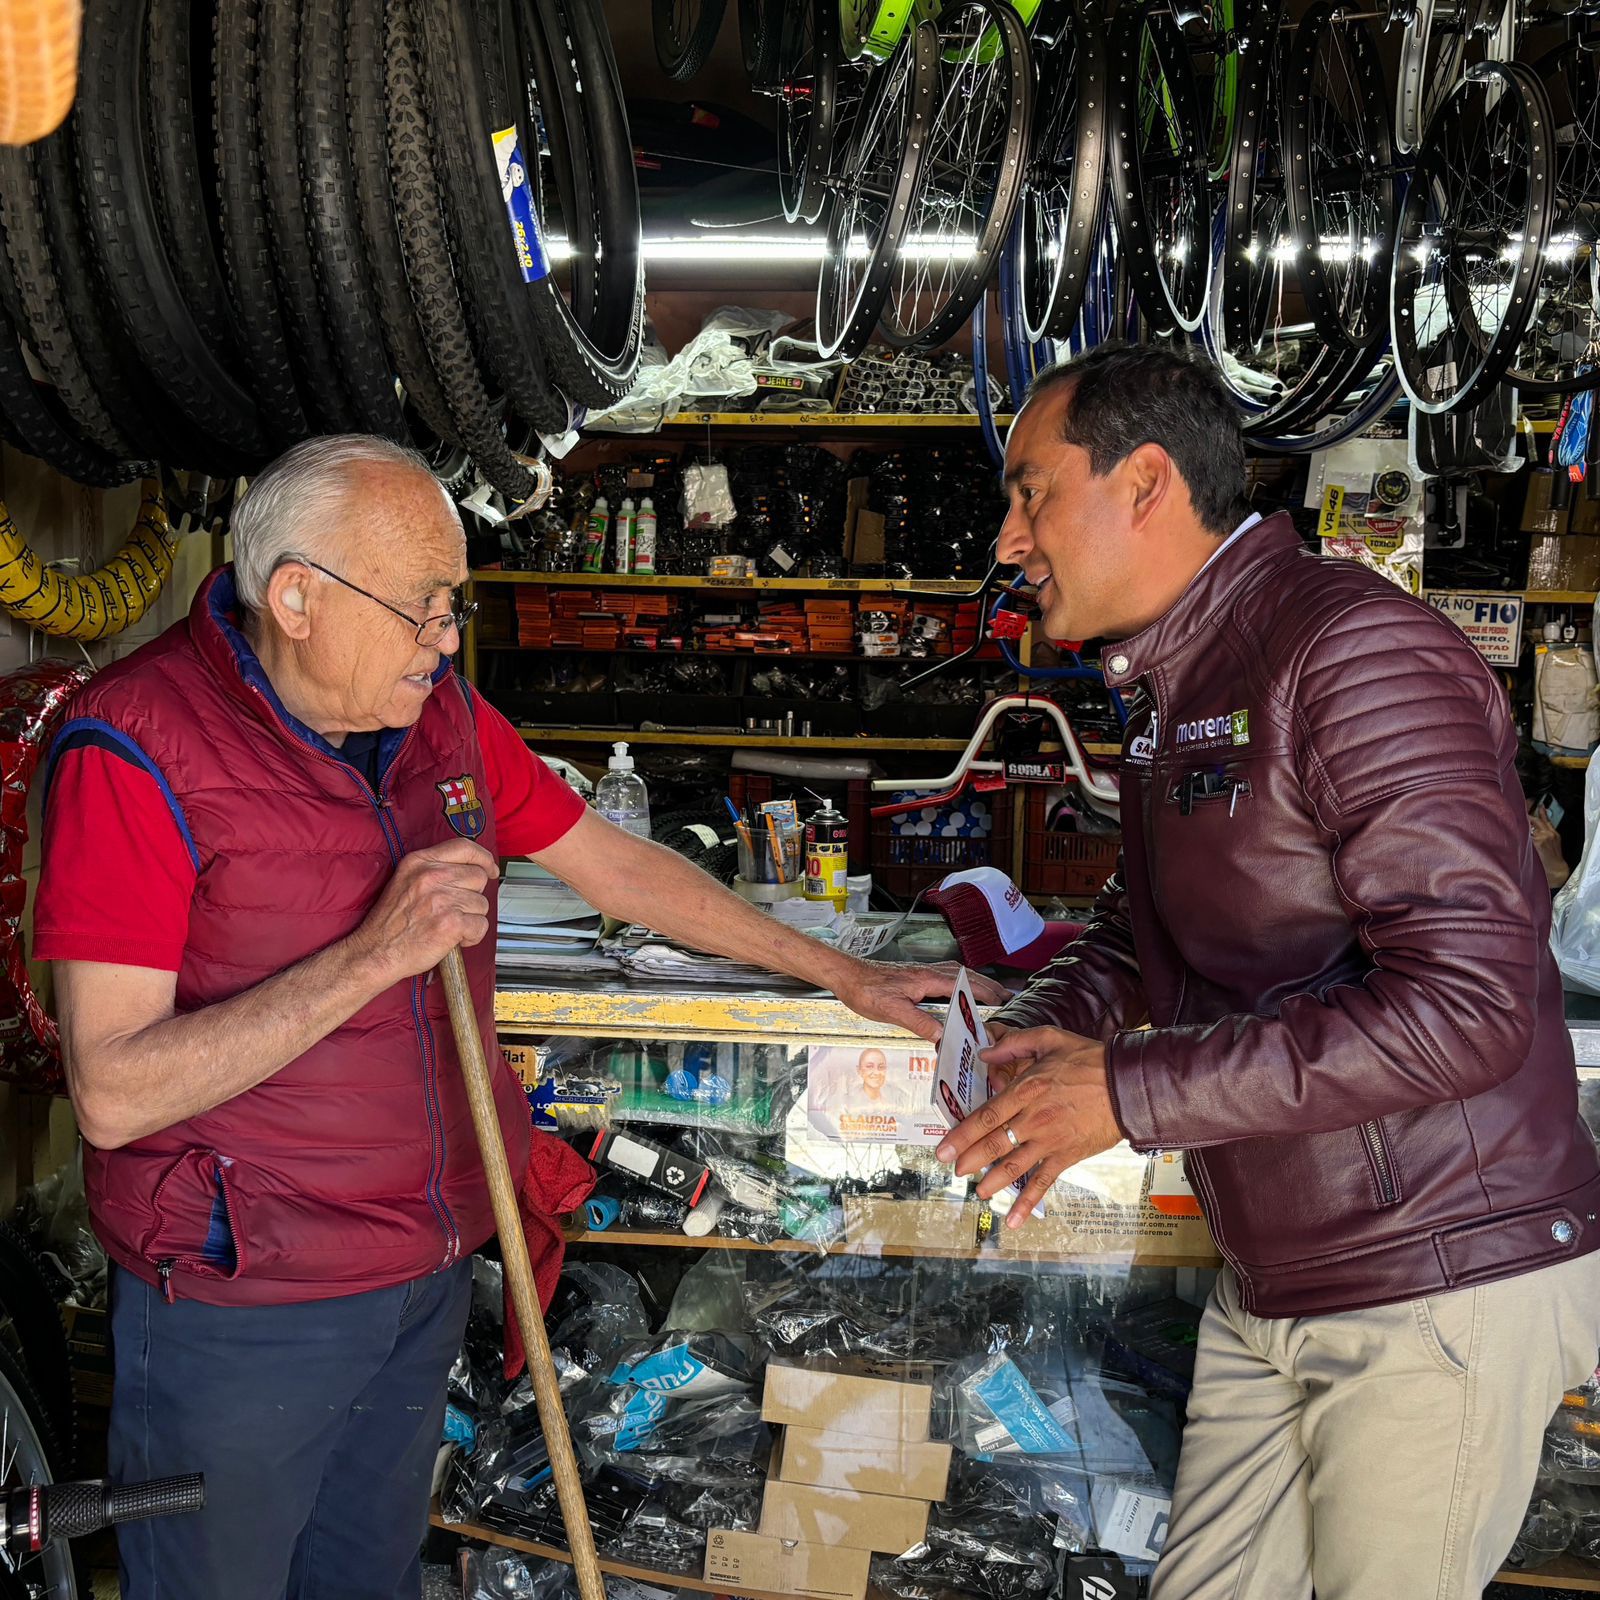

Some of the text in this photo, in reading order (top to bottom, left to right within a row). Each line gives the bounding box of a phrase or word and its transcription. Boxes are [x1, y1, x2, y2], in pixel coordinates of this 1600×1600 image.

[1454, 599, 1474, 611] NO
[1474, 603, 1517, 624] FIO
[1488, 626, 1509, 635] PERDIDO
[1176, 714, 1232, 744] morena
[957, 1038, 973, 1104] morena
[840, 1114, 897, 1124] CLAUDIA
